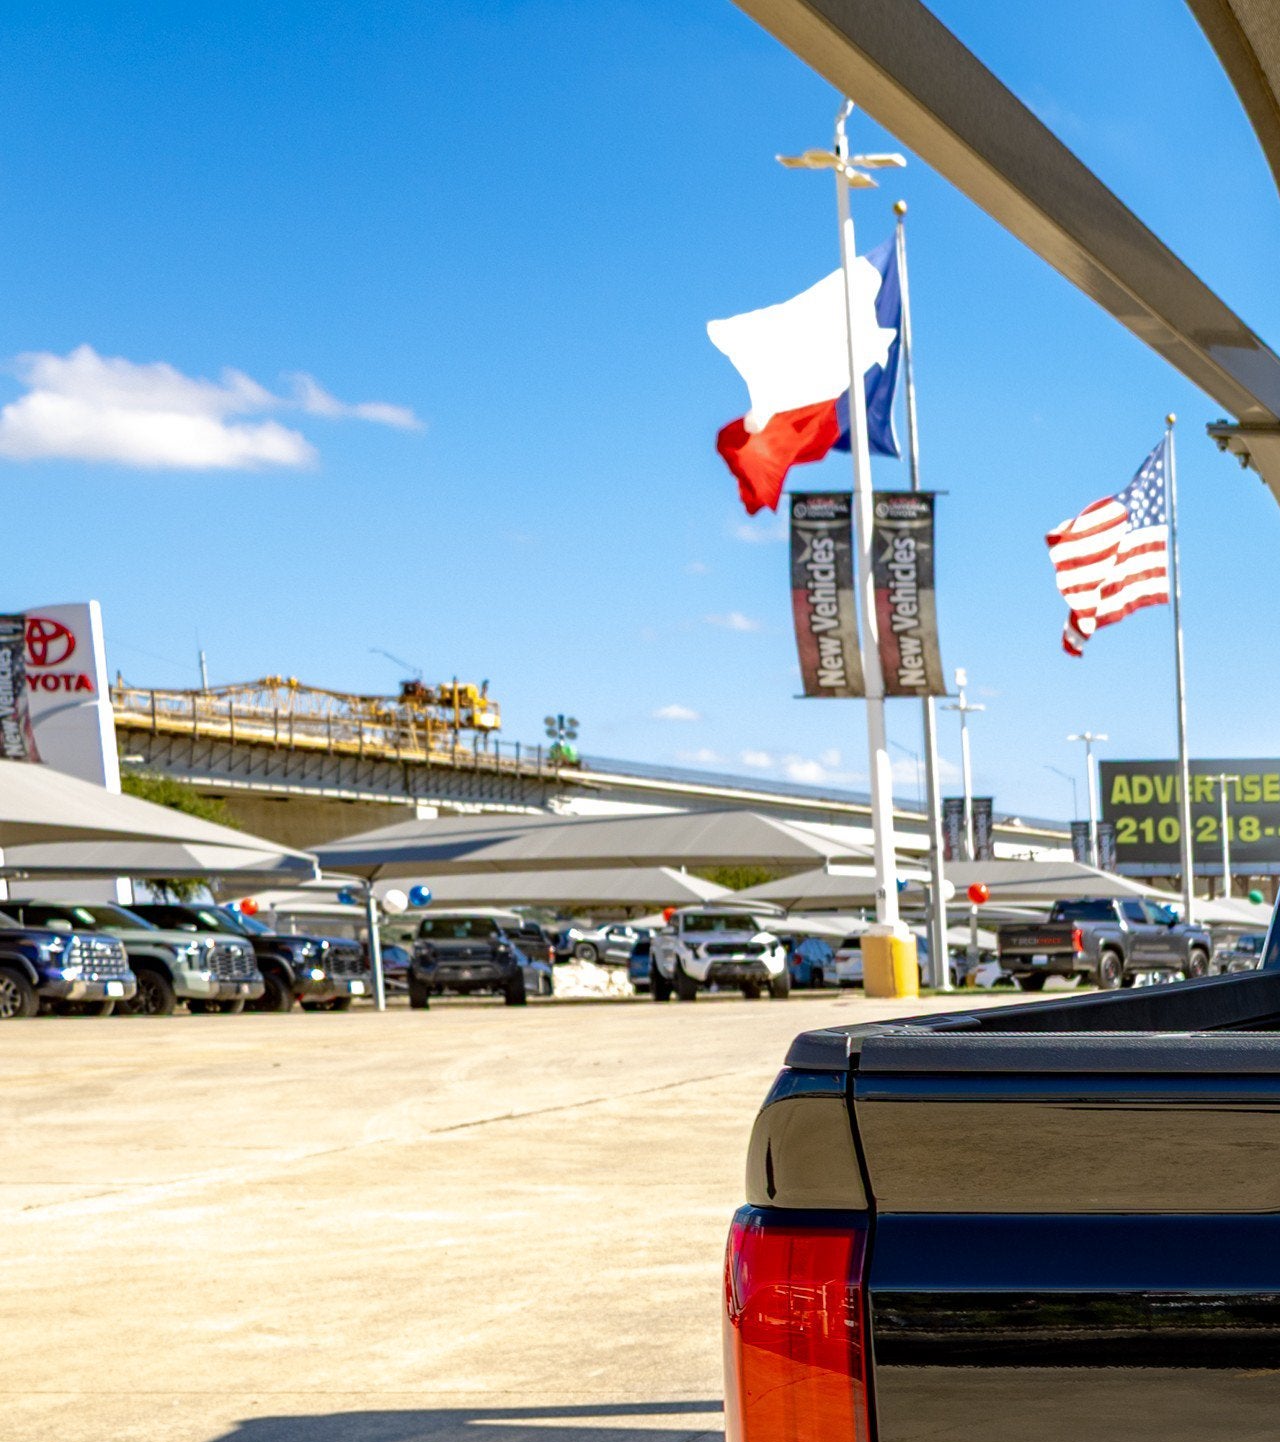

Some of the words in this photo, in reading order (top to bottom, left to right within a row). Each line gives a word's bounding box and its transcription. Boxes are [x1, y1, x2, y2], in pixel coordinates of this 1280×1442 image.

[807, 538, 839, 632] Vehicles
[889, 538, 919, 632] Vehicles
[817, 637, 847, 687] New
[899, 636, 927, 686] New
